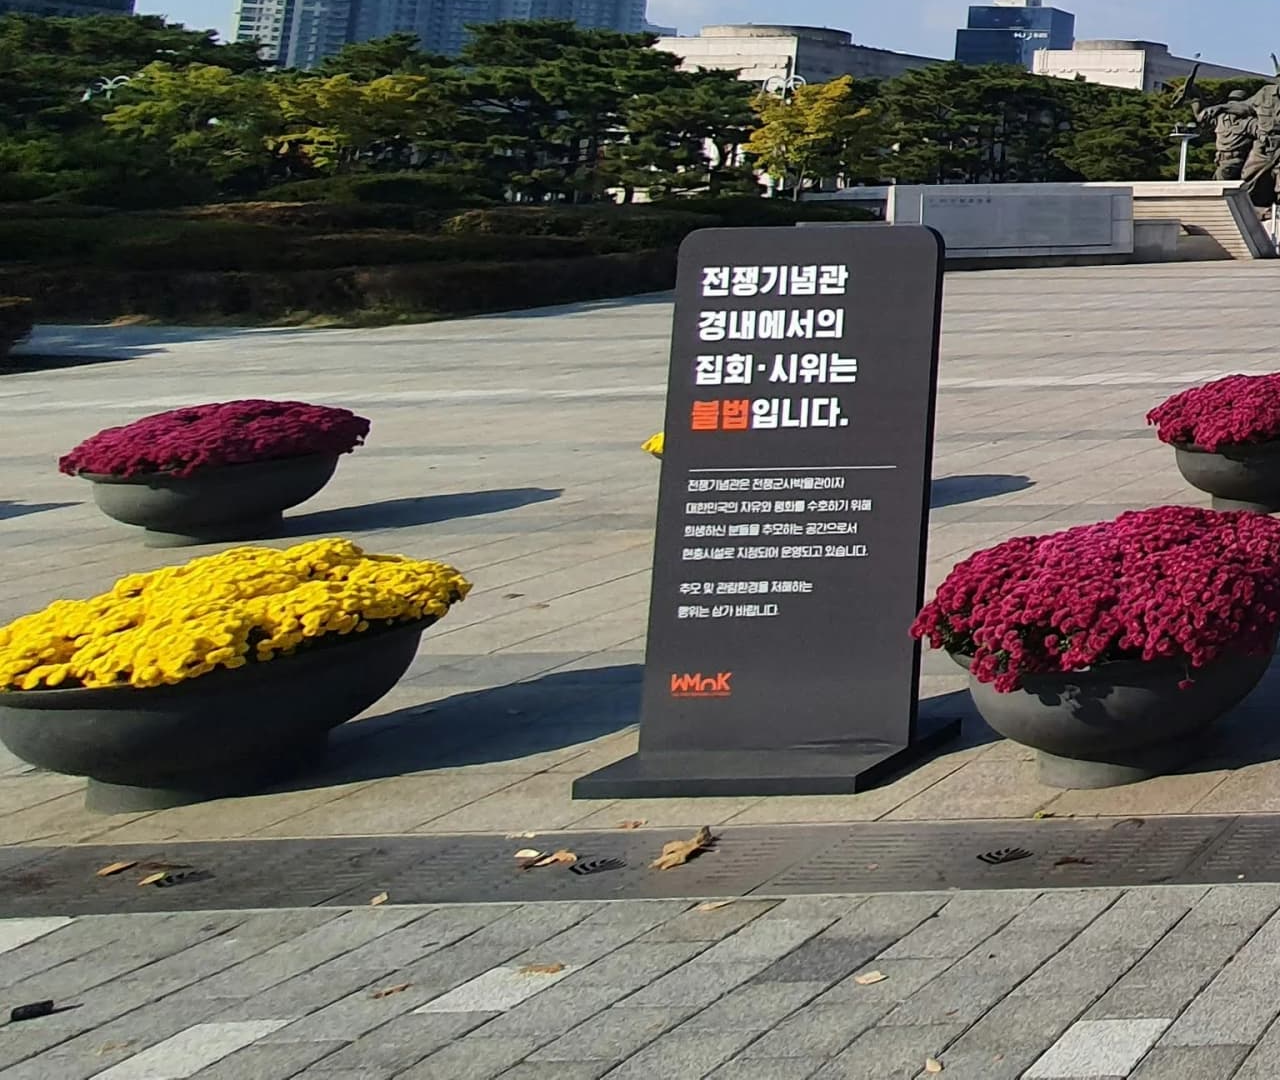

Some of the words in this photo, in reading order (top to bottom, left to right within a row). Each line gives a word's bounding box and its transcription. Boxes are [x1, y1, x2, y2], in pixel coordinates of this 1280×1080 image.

[702, 264, 849, 297] 전쟁기념관
[698, 308, 845, 341] 경내에서의
[690, 397, 849, 431] 불법입니다.
[687, 478, 751, 492] 전쟁기념관은
[752, 477, 845, 490] 전쟁군사박물관이자
[685, 501, 738, 514] 대한민국의
[740, 501, 771, 513] 자유와
[774, 500, 805, 513] 평화를
[807, 499, 849, 512] 수호하기
[850, 498, 872, 511] 위해
[684, 524, 726, 537] 희생하신
[728, 523, 760, 536] 분들을
[762, 522, 803, 535] 추모하는
[805, 522, 858, 535] 공간으로서
[682, 547, 735, 560] 현충시설로
[737, 546, 779, 559] 지정되어
[781, 545, 824, 558] 운영되고
[824, 544, 869, 557] 있습니다.
[679, 582, 702, 595] 추모
[703, 581, 714, 595] 및
[716, 581, 769, 594] 관람환경을
[770, 580, 813, 593] 저해하는
[678, 605, 710, 618] 행위는
[711, 605, 734, 617] 삼가
[735, 603, 780, 617] 바랍니다.
